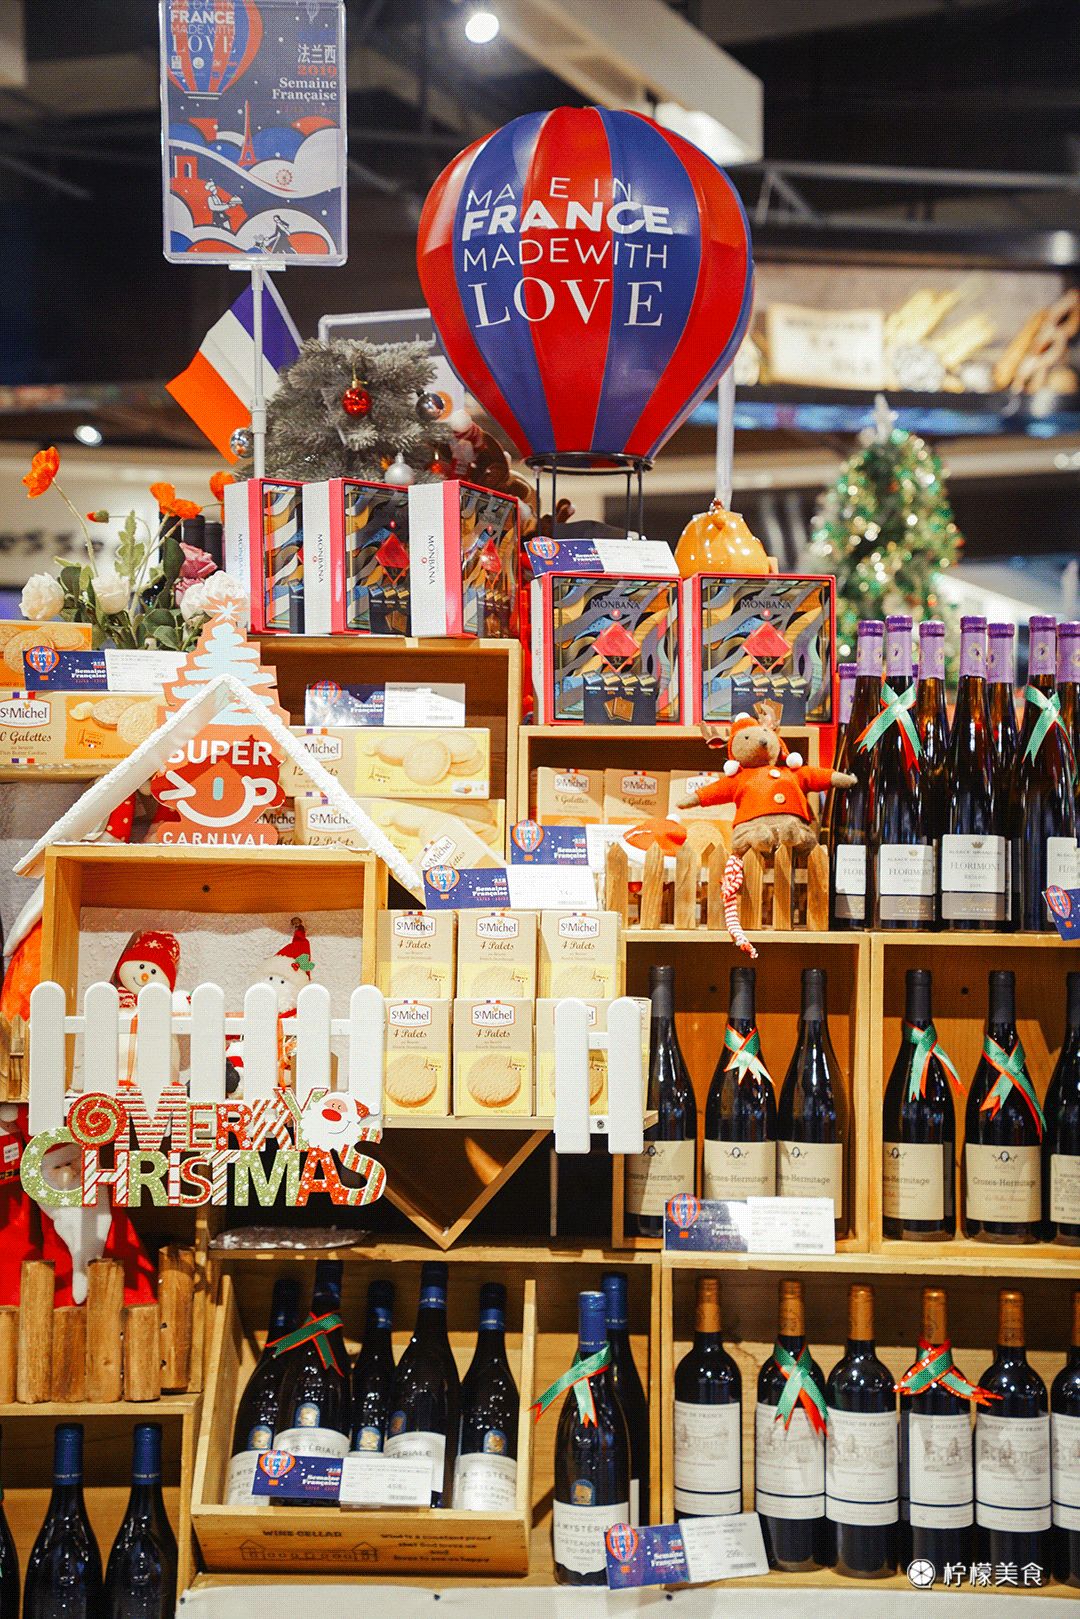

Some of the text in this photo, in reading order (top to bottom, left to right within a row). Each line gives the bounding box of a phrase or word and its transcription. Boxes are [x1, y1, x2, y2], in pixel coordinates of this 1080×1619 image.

[171, 10, 235, 25] FRANCE
[171, 24, 236, 34] MADE WITH
[172, 35, 237, 53] LOVE
[297, 44, 337, 64] 法兰西
[297, 65, 337, 76] 2019
[279, 77, 337, 89] Semaine
[272, 88, 337, 102] Française
[461, 199, 674, 242] FRANCE
[467, 276, 664, 328] LOVE
[316, 533, 324, 584] MONBANA
[428, 534, 436, 586] MONBANA
[591, 599, 641, 611] MONBANA
[741, 599, 792, 611] MONBANA
[9, 731, 52, 745] Galettes
[167, 739, 272, 766] SUPER
[162, 831, 266, 846] CARNIVAL
[405, 939, 432, 949] Palets
[488, 940, 514, 951] Palets
[569, 940, 596, 951] Palets
[401, 1028, 427, 1039] Palets
[484, 1028, 511, 1039] Palets
[113, 1083, 330, 1152] MERRY
[19, 1125, 388, 1208] CHRISTMAS
